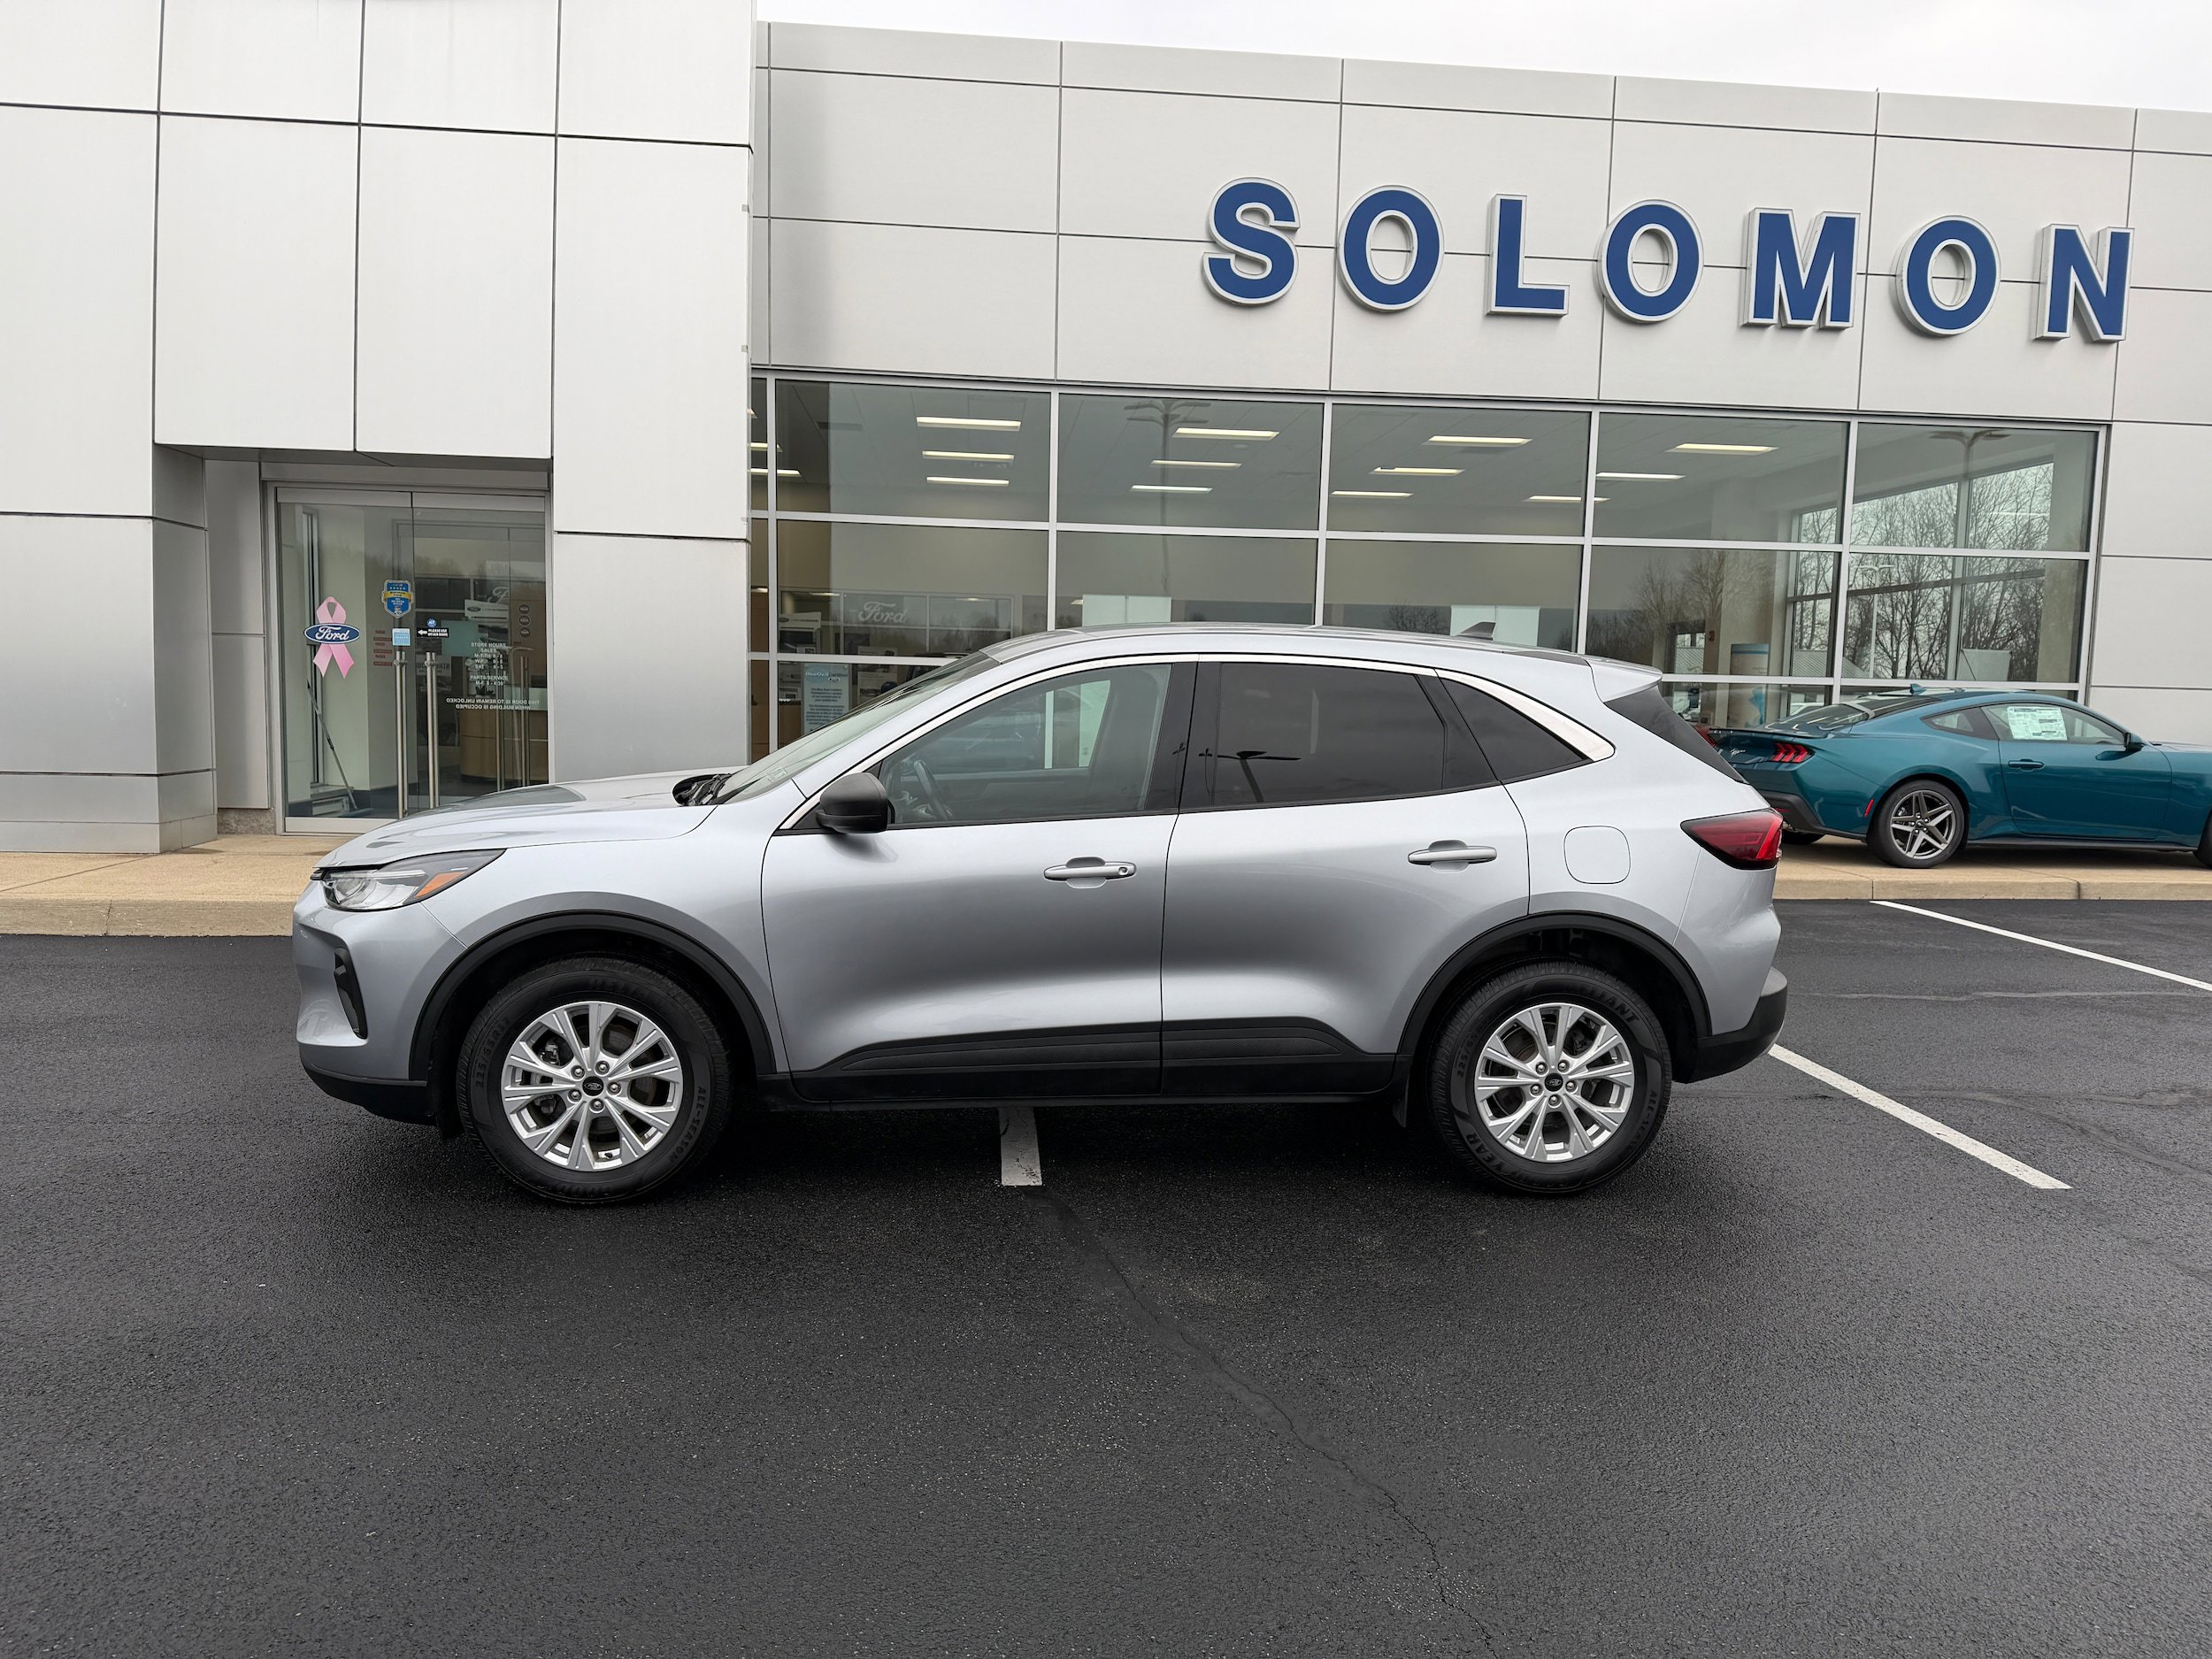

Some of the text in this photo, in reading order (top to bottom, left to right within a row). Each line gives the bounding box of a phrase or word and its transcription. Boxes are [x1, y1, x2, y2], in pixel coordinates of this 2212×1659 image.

[1202, 176, 2136, 342] SOLOMON
[315, 626, 350, 641] Ford
[858, 601, 909, 624] Ford
[670, 1086, 707, 1166] ALL-SEASON
